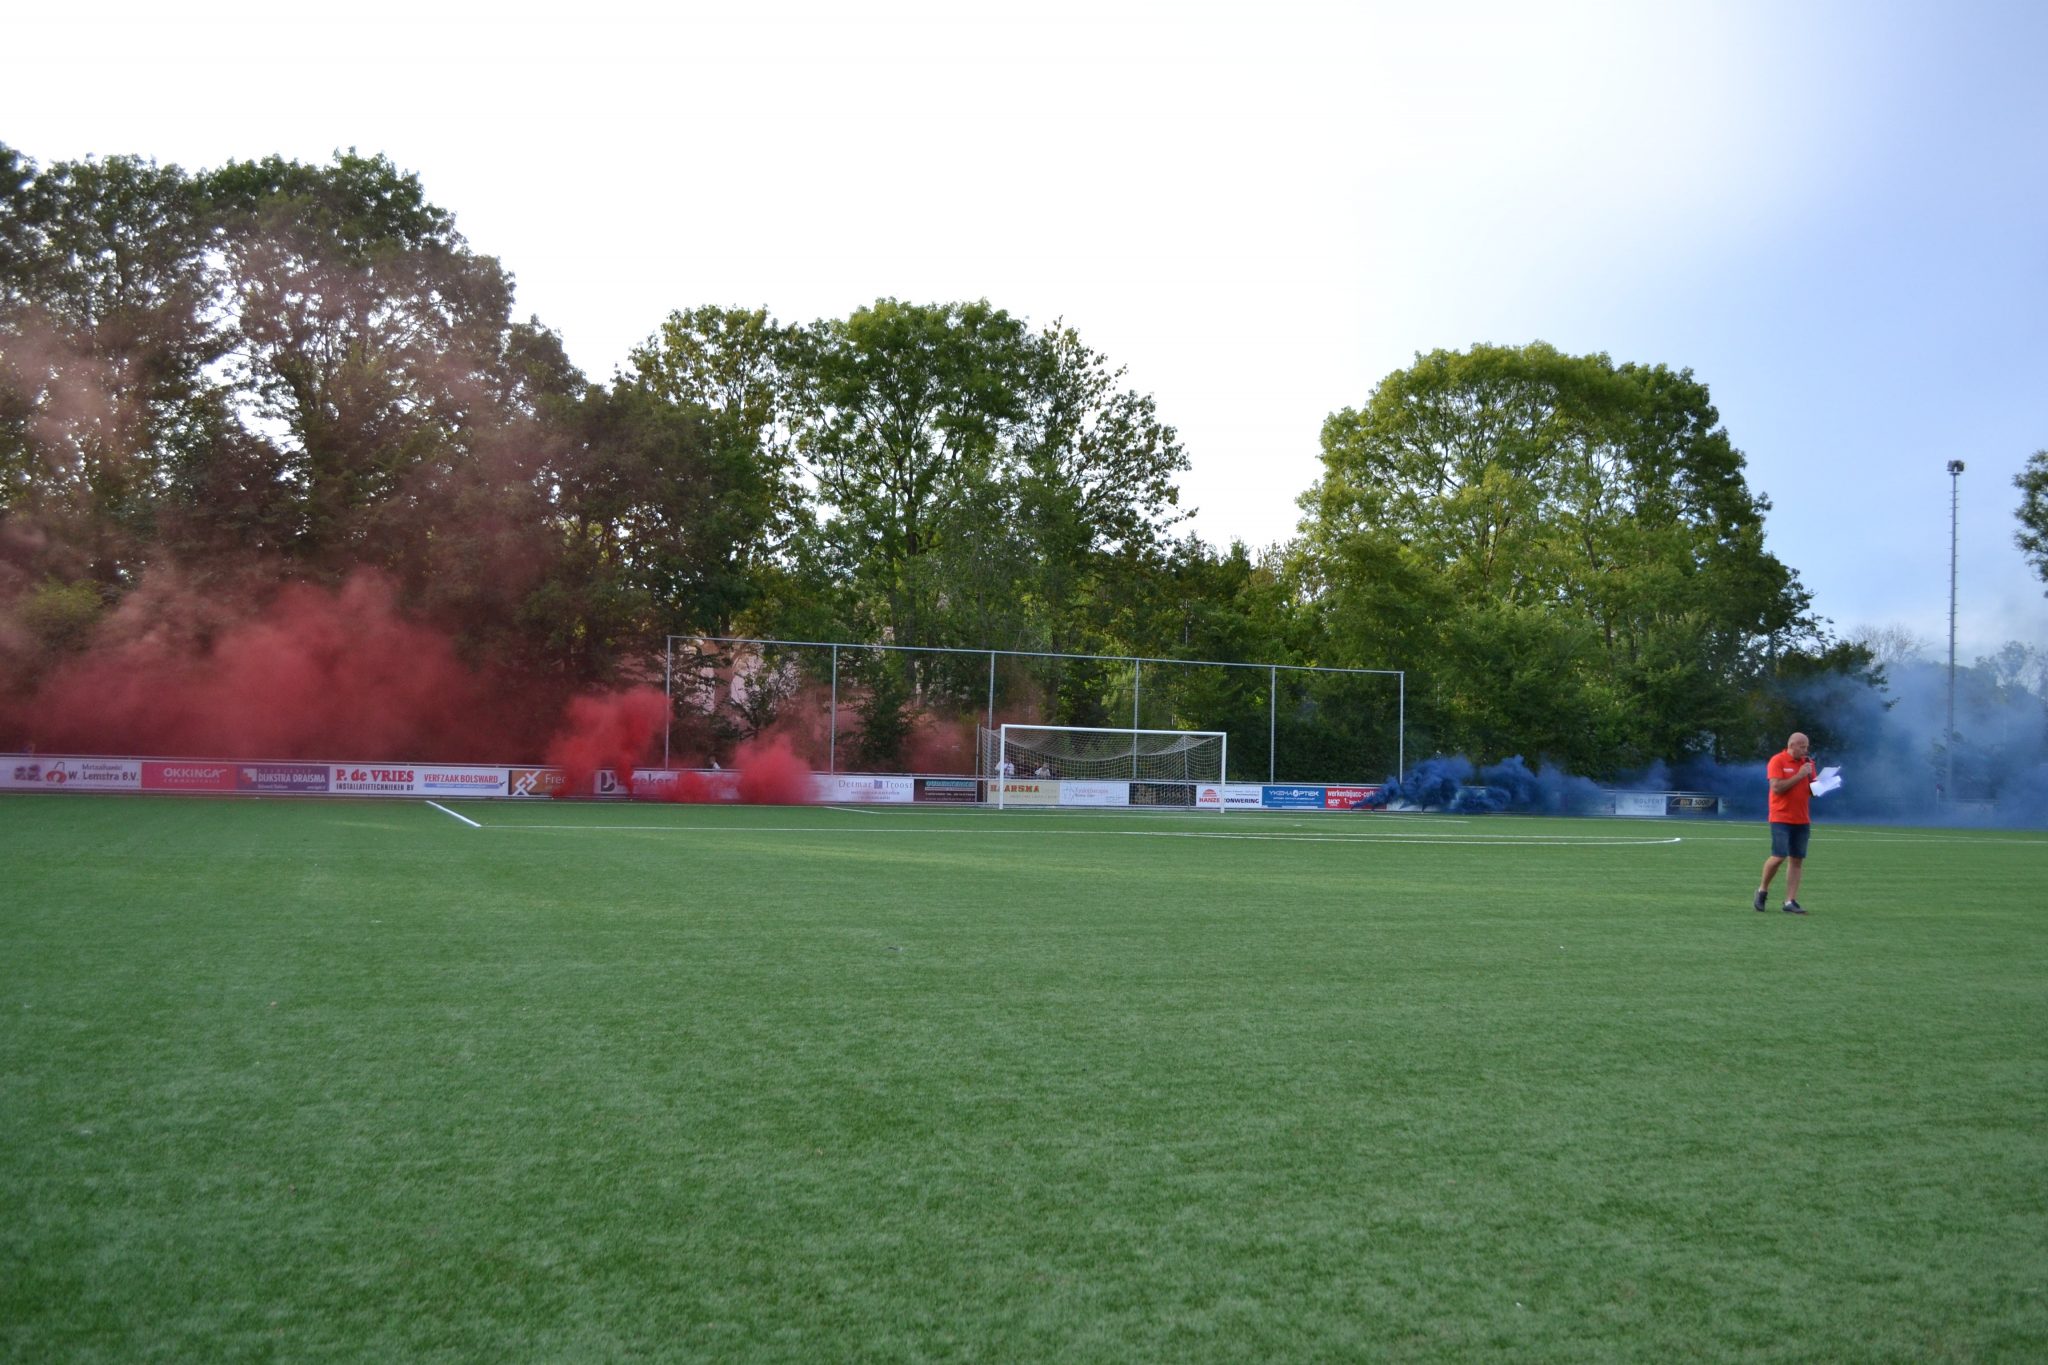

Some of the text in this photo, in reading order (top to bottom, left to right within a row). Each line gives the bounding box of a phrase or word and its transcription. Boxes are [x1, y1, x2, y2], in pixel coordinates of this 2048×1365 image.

[83, 771, 120, 781] Lemstra
[163, 767, 221, 778] OKKINGA
[336, 769, 414, 783] P. de VRIES
[258, 773, 326, 783] DIJKSTRA DRAISMA
[424, 773, 499, 784] VERFZAAK BOLSWARD
[838, 780, 913, 789] Detmar Troost
[990, 784, 1040, 793] HARSMA
